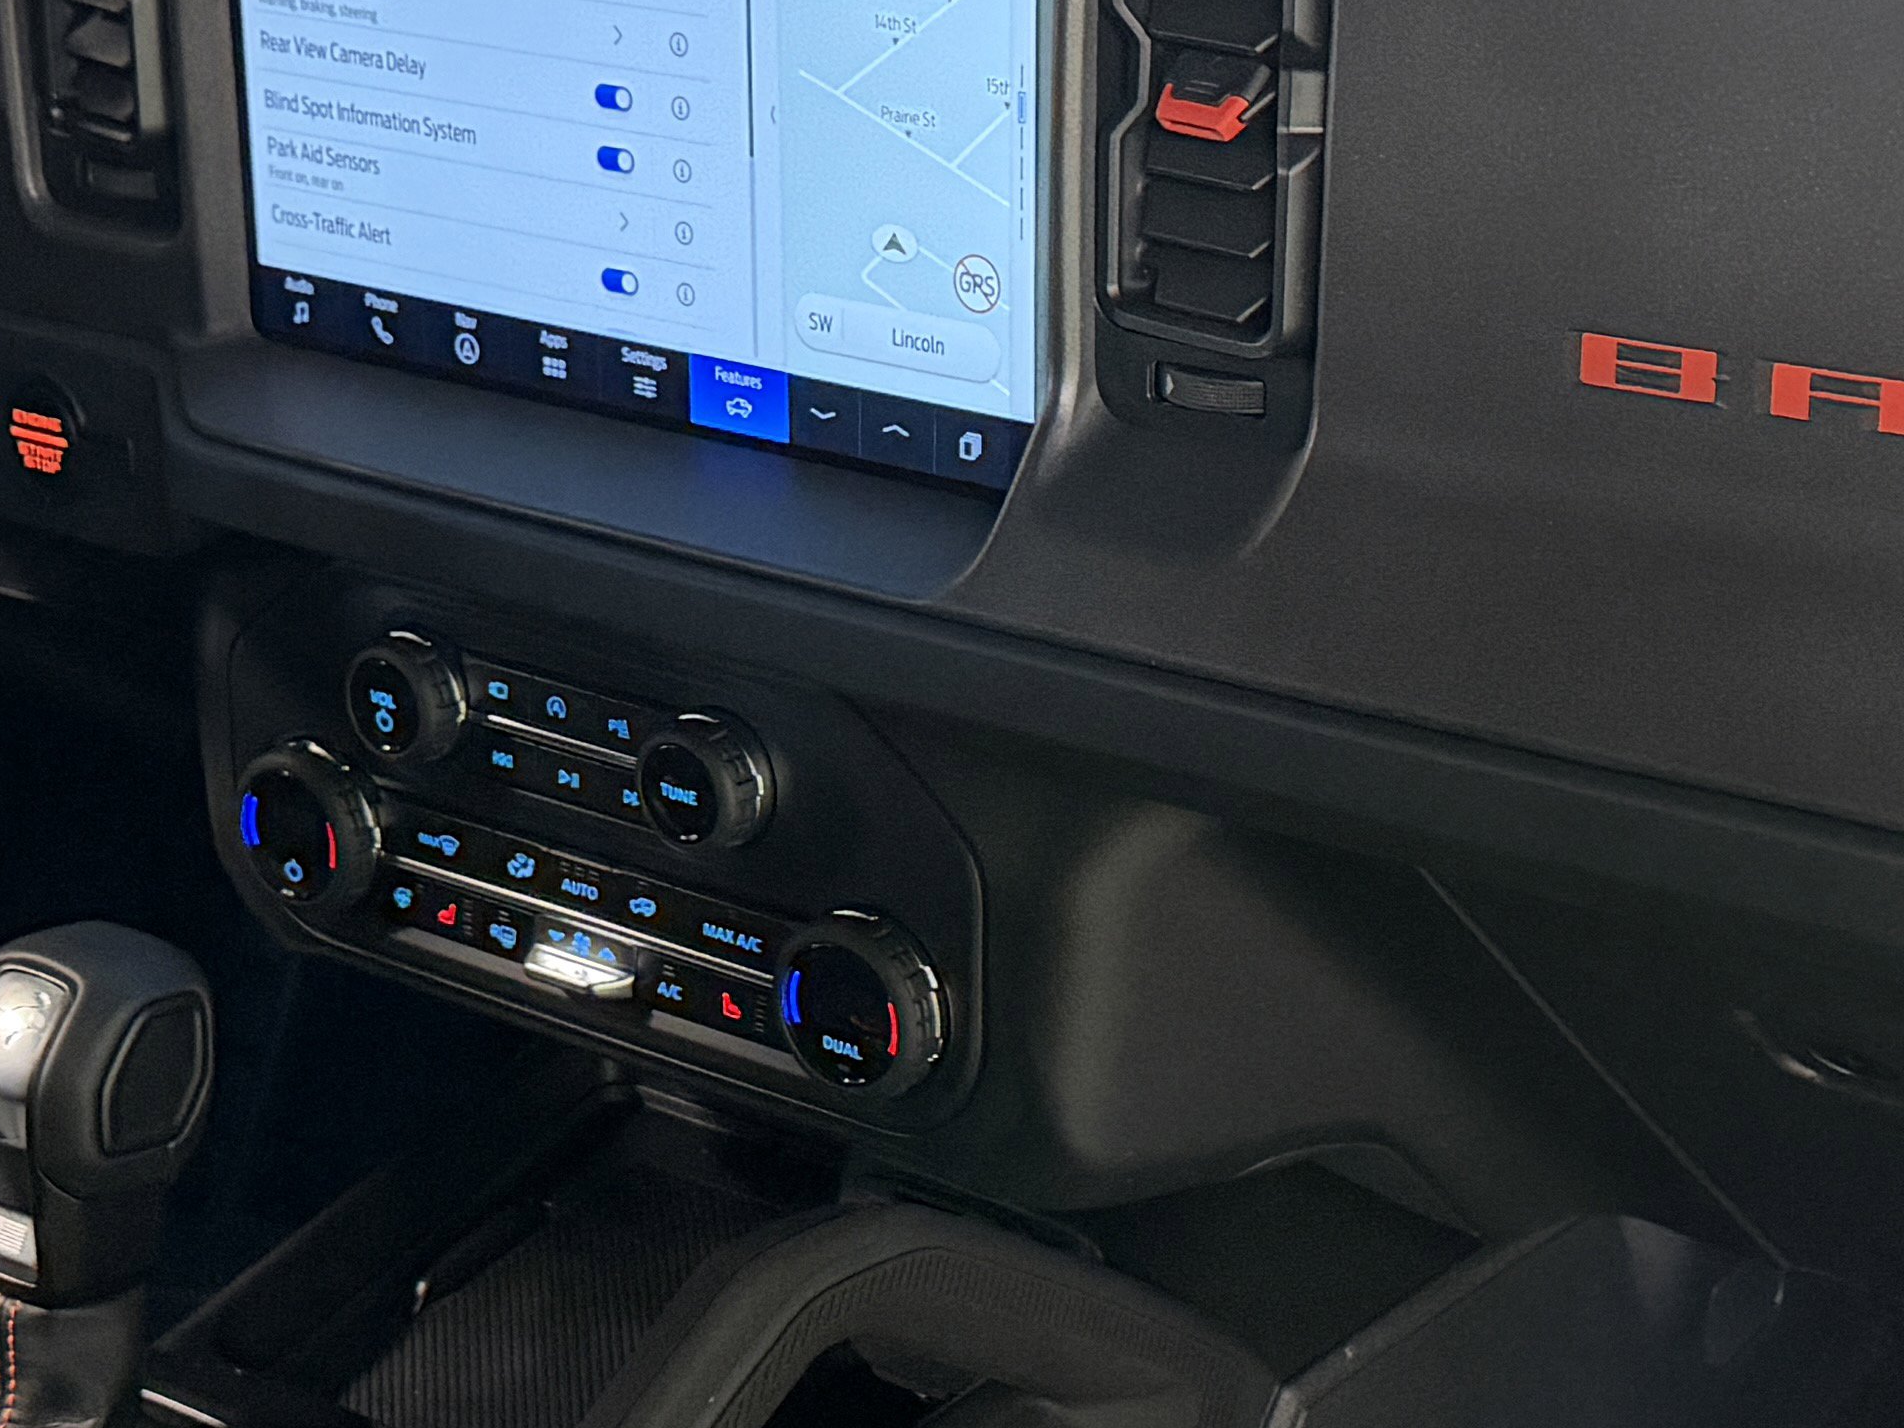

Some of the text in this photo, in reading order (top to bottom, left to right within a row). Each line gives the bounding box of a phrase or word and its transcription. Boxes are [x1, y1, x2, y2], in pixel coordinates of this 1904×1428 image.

[874, 13, 918, 35] 14th St
[260, 29, 427, 81] Rear View Camera Delay
[264, 88, 478, 147] Blind Spot Information System
[922, 110, 937, 129] St
[267, 135, 381, 175] Park Aid Sensors
[271, 203, 393, 247] Cross-Traffic Alert
[808, 311, 946, 357] SW Lincoln
[714, 364, 764, 391] Features
[370, 688, 397, 710] VOL
[659, 781, 698, 807] TUNE
[561, 878, 598, 901] AUTO
[702, 922, 763, 954] MAX A/C
[656, 980, 683, 1002] A/C
[822, 1034, 863, 1060] DUAL
